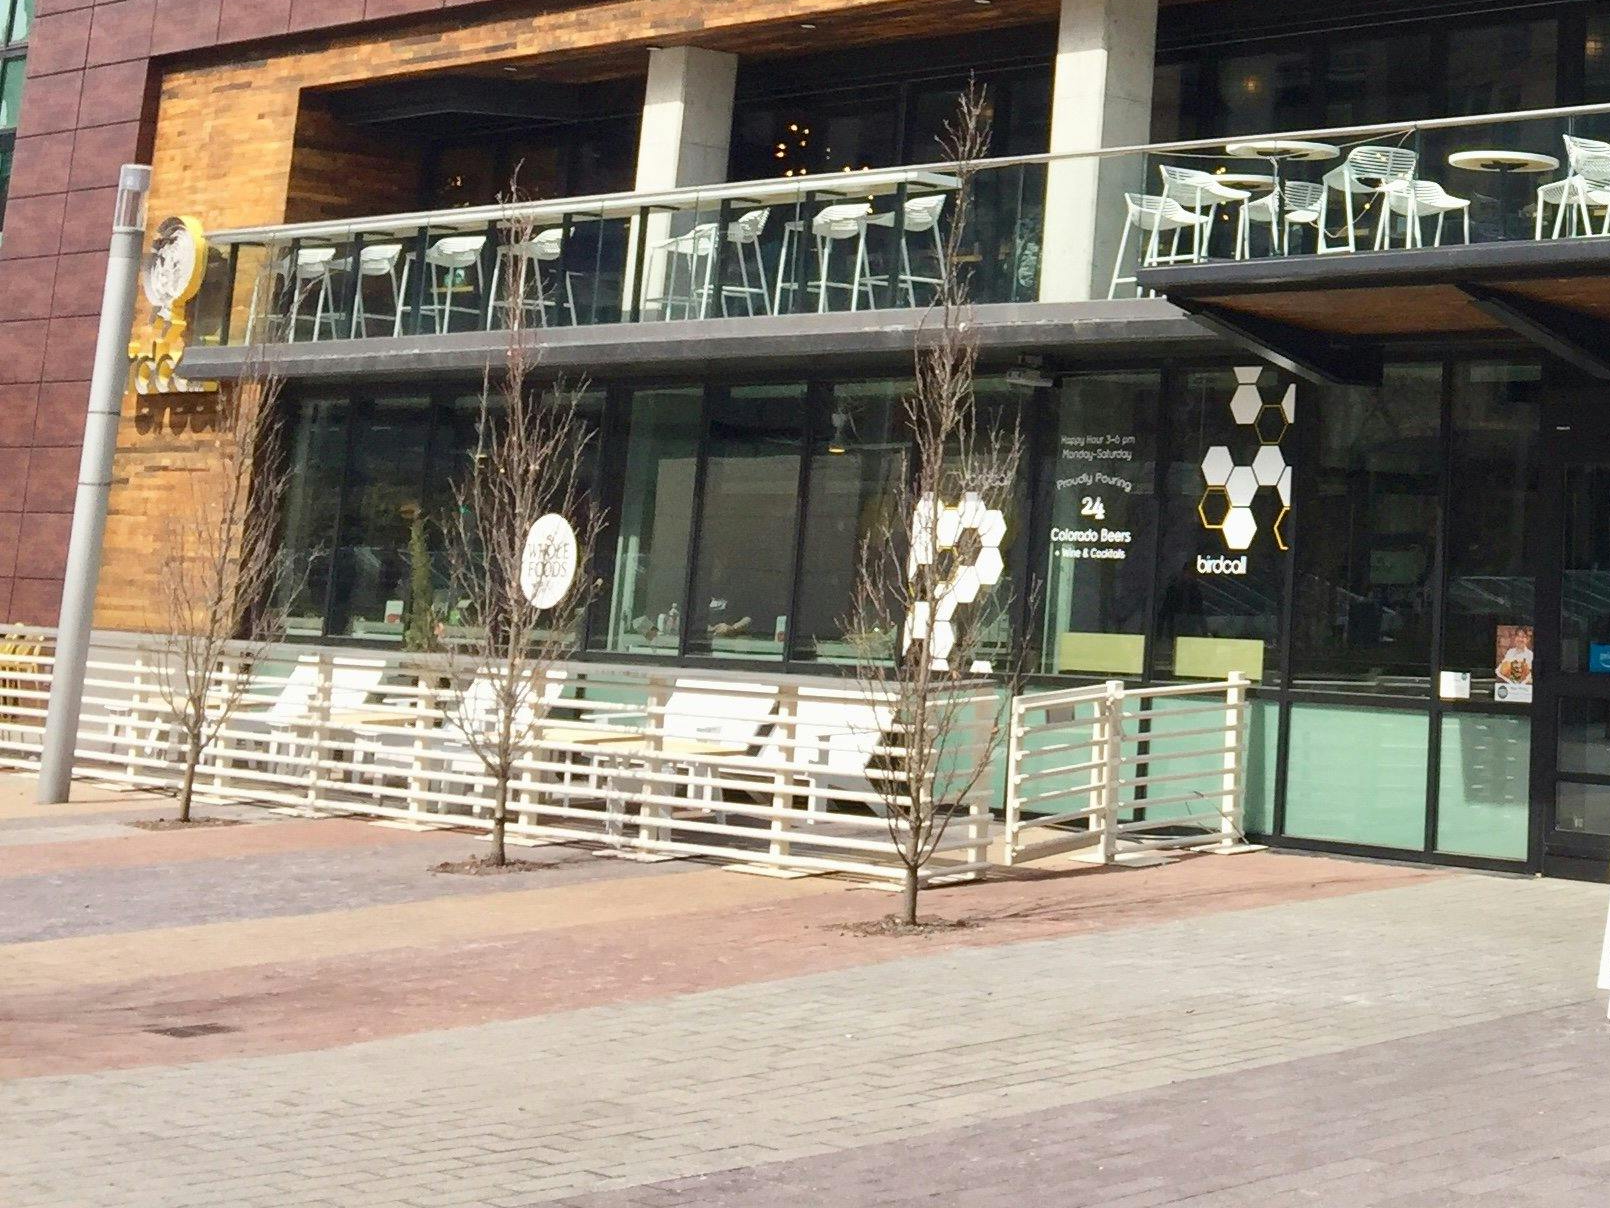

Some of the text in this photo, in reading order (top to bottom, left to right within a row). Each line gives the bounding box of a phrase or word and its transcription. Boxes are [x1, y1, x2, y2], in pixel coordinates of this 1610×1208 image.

[1057, 472, 1132, 493] Proudly Pouring
[1081, 496, 1105, 520] 24
[1050, 527, 1132, 543] Colorado Beers
[527, 534, 570, 560] WHOLE
[528, 561, 568, 578] FOODS
[1196, 554, 1247, 575] birdcall
